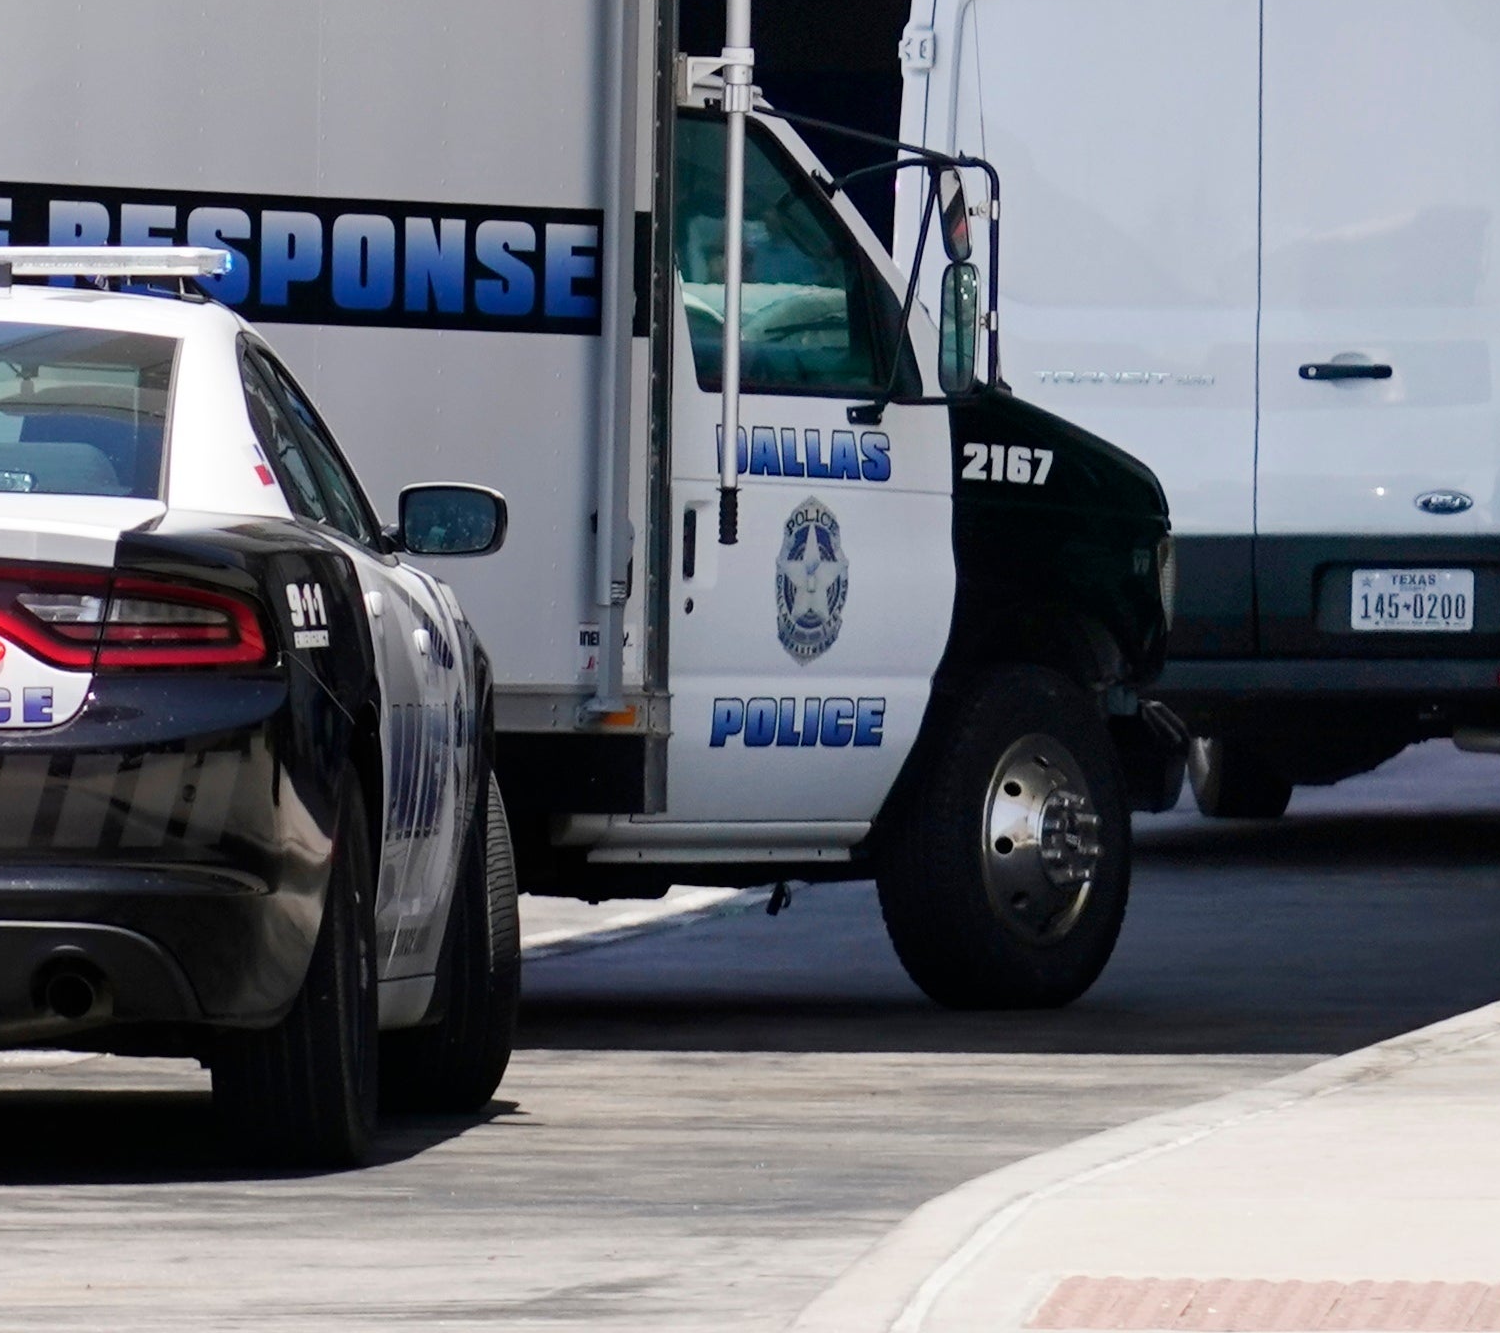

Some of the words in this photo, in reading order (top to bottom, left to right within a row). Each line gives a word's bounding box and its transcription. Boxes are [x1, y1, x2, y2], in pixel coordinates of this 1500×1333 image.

[48, 199, 597, 319] RESPONSE
[716, 424, 891, 482] DALLAS
[962, 442, 1053, 485] 2167
[787, 510, 838, 537] POLICE
[1392, 574, 1436, 586] TEXAS
[709, 697, 886, 747] POLICE
